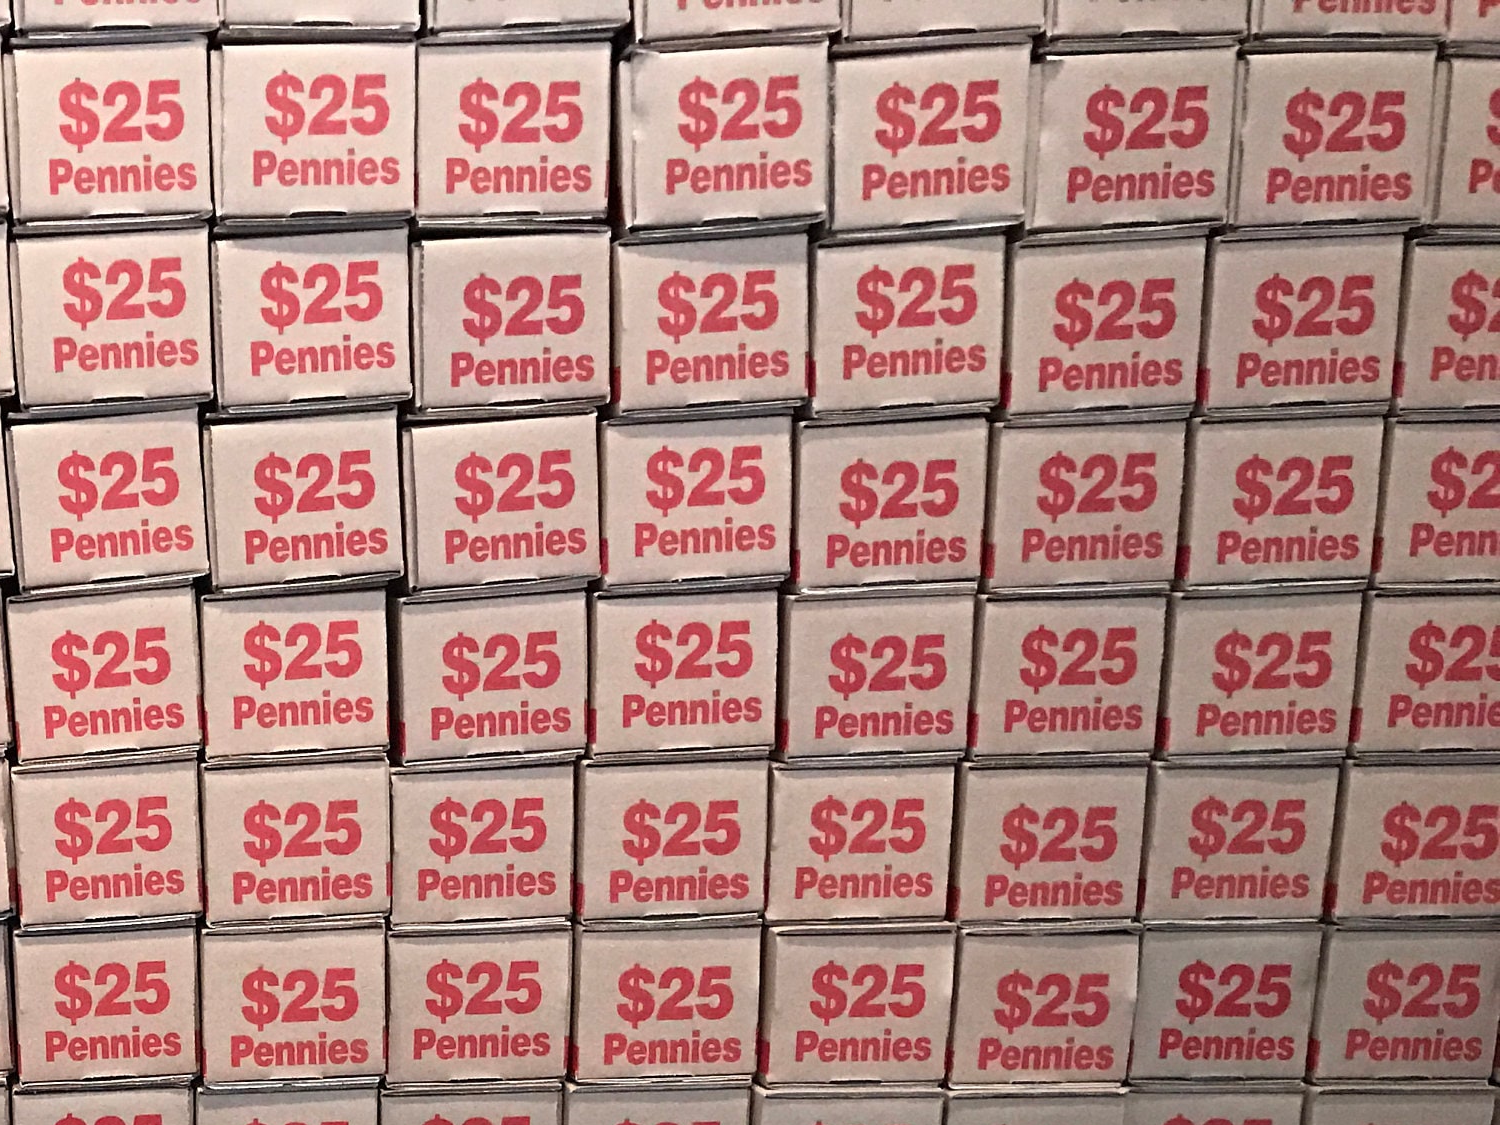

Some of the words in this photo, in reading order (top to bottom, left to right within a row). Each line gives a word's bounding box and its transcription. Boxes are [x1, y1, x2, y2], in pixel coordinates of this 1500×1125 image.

[264, 71, 390, 145] $25
[678, 75, 803, 152] $25
[1083, 85, 1209, 159] $25
[252, 148, 400, 187] Pennies
[665, 158, 813, 195] Pennies
[1066, 165, 1215, 204] Pennies
[62, 256, 186, 331] $25
[462, 274, 585, 346] $25
[856, 264, 978, 339] $25
[1252, 274, 1375, 345] $25
[53, 331, 199, 372] Pennies
[450, 348, 594, 388] Pennies
[843, 340, 986, 380] Pennies
[1236, 350, 1380, 388] Pennies
[58, 446, 180, 522] $25
[646, 445, 766, 518] $25
[1037, 451, 1158, 522] $25
[50, 519, 194, 563] Pennies
[634, 516, 776, 557] Pennies
[1021, 525, 1163, 562] Pennies
[442, 630, 561, 701] $25
[1020, 625, 1138, 694] $25
[430, 700, 571, 741] Pennies
[1004, 697, 1143, 733] Pennies
[54, 795, 173, 865] $25
[428, 796, 547, 864] $25
[808, 795, 927, 862] $25
[1188, 796, 1306, 862] $25
[46, 863, 185, 903] Pennies
[417, 864, 557, 901] Pennies
[794, 865, 933, 900] Pennies
[1171, 866, 1309, 899] Pennies
[241, 966, 359, 1032] $25
[616, 963, 734, 1029] $25
[994, 970, 1110, 1035] $25
[1364, 960, 1480, 1023] $25
[230, 1031, 369, 1068] Pennies
[603, 1030, 742, 1065] Pennies
[977, 1037, 1114, 1071] Pennies
[1345, 1028, 1481, 1061] Pennies
